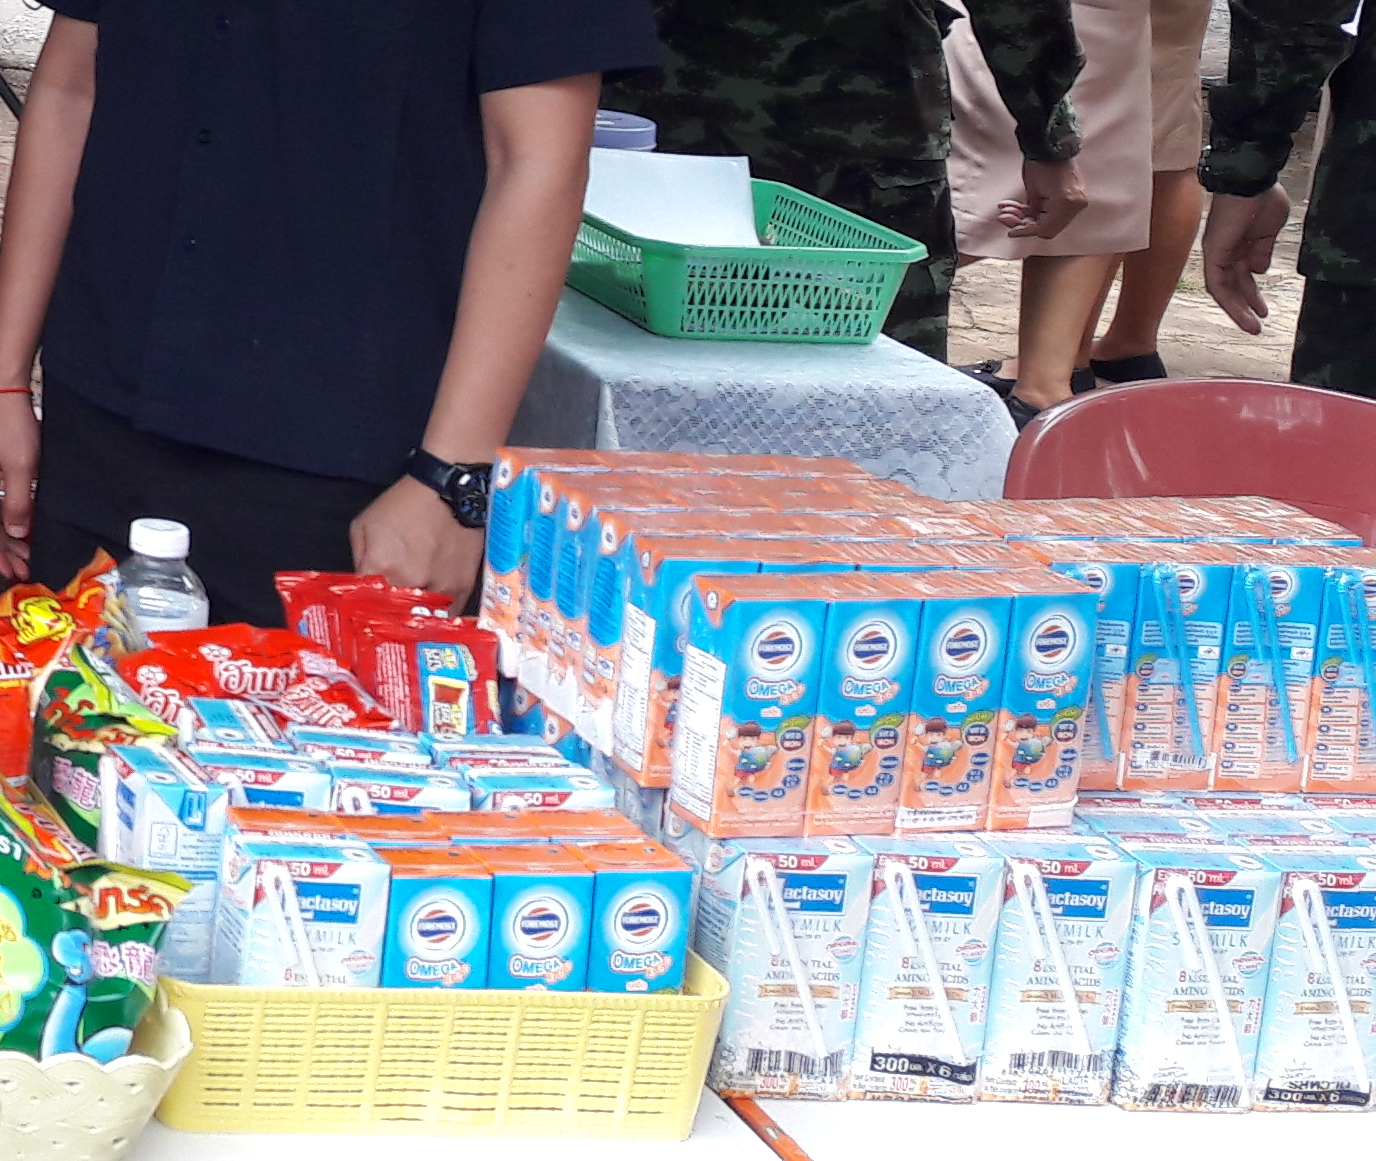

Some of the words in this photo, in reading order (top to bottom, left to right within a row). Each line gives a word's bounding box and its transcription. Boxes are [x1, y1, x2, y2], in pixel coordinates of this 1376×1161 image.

[748, 680, 796, 697] OMEGA
[844, 679, 890, 697] OMEGA
[936, 675, 980, 693] OMEGA
[1026, 673, 1069, 690] OMEGA
[370, 785, 391, 800] 50
[523, 793, 543, 805] 50
[291, 862, 312, 877] 50
[778, 855, 797, 869] 50
[909, 857, 928, 871] 50
[1041, 860, 1062, 875] 50
[1190, 871, 1207, 884] 50
[1319, 873, 1337, 887] 50
[778, 882, 845, 908] actasoy
[915, 887, 974, 910] actasoy
[1046, 889, 1108, 914] actasoy
[294, 895, 359, 918] actasoy
[1198, 900, 1251, 923] ctasoy
[1328, 904, 1376, 926] actasoy
[410, 957, 458, 977] OMEGA
[512, 956, 562, 977] OMEGA
[612, 954, 661, 971] OMEGA
[771, 957, 780, 967] 8
[901, 957, 910, 969] 8
[1033, 959, 1042, 973] 8
[1178, 970, 1187, 983] 8
[1307, 972, 1316, 985] 8
[873, 1055, 909, 1072] 300
[938, 1064, 952, 1077] 6
[1268, 1089, 1303, 1102] 300
